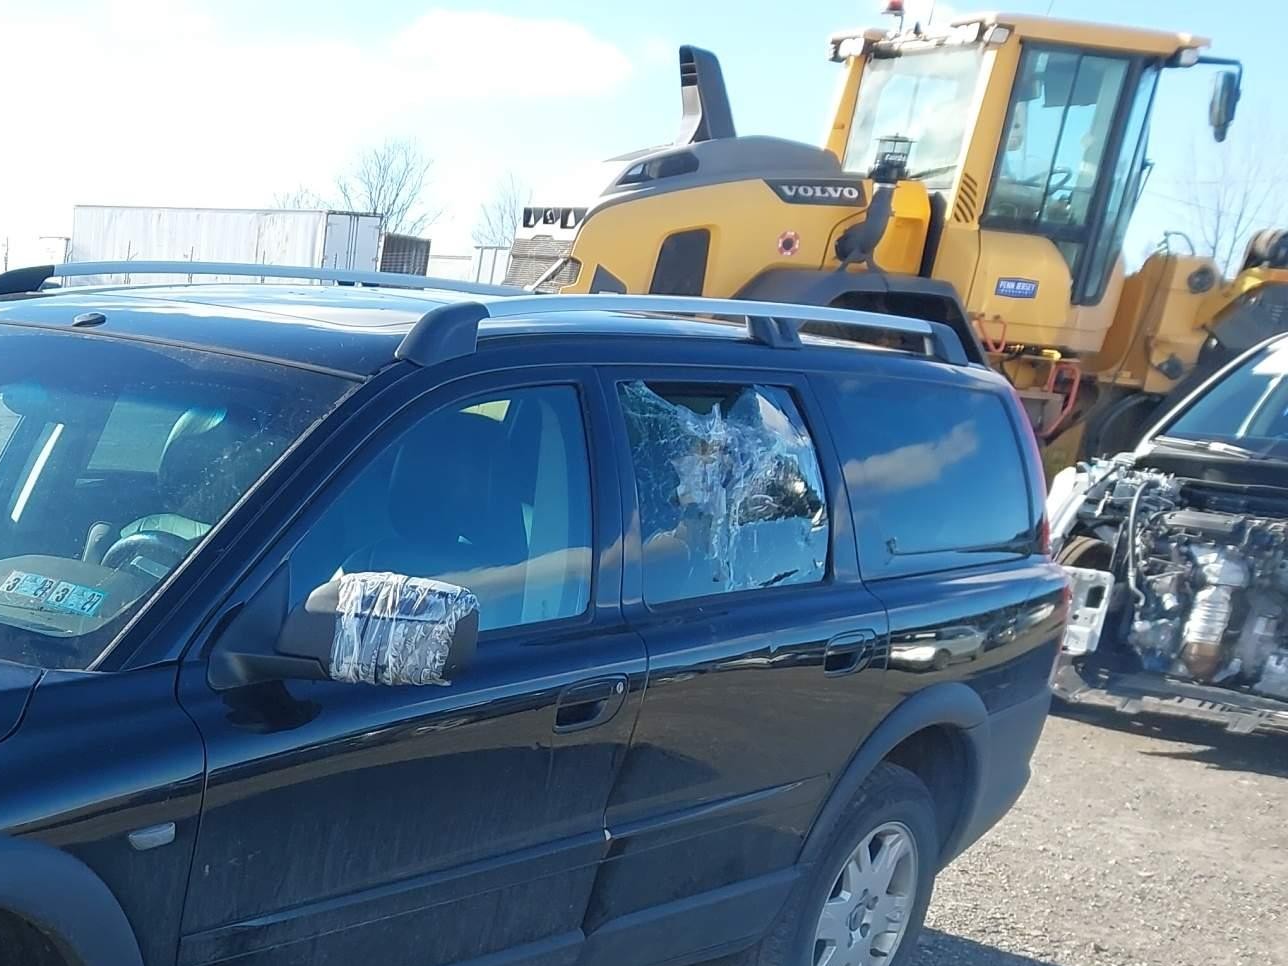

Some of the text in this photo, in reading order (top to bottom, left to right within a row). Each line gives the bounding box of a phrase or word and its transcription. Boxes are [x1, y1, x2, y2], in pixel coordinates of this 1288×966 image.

[781, 185, 859, 198] VOLVO
[6, 577, 21, 592] 3
[55, 587, 70, 603] 3
[81, 592, 102, 613] 27
